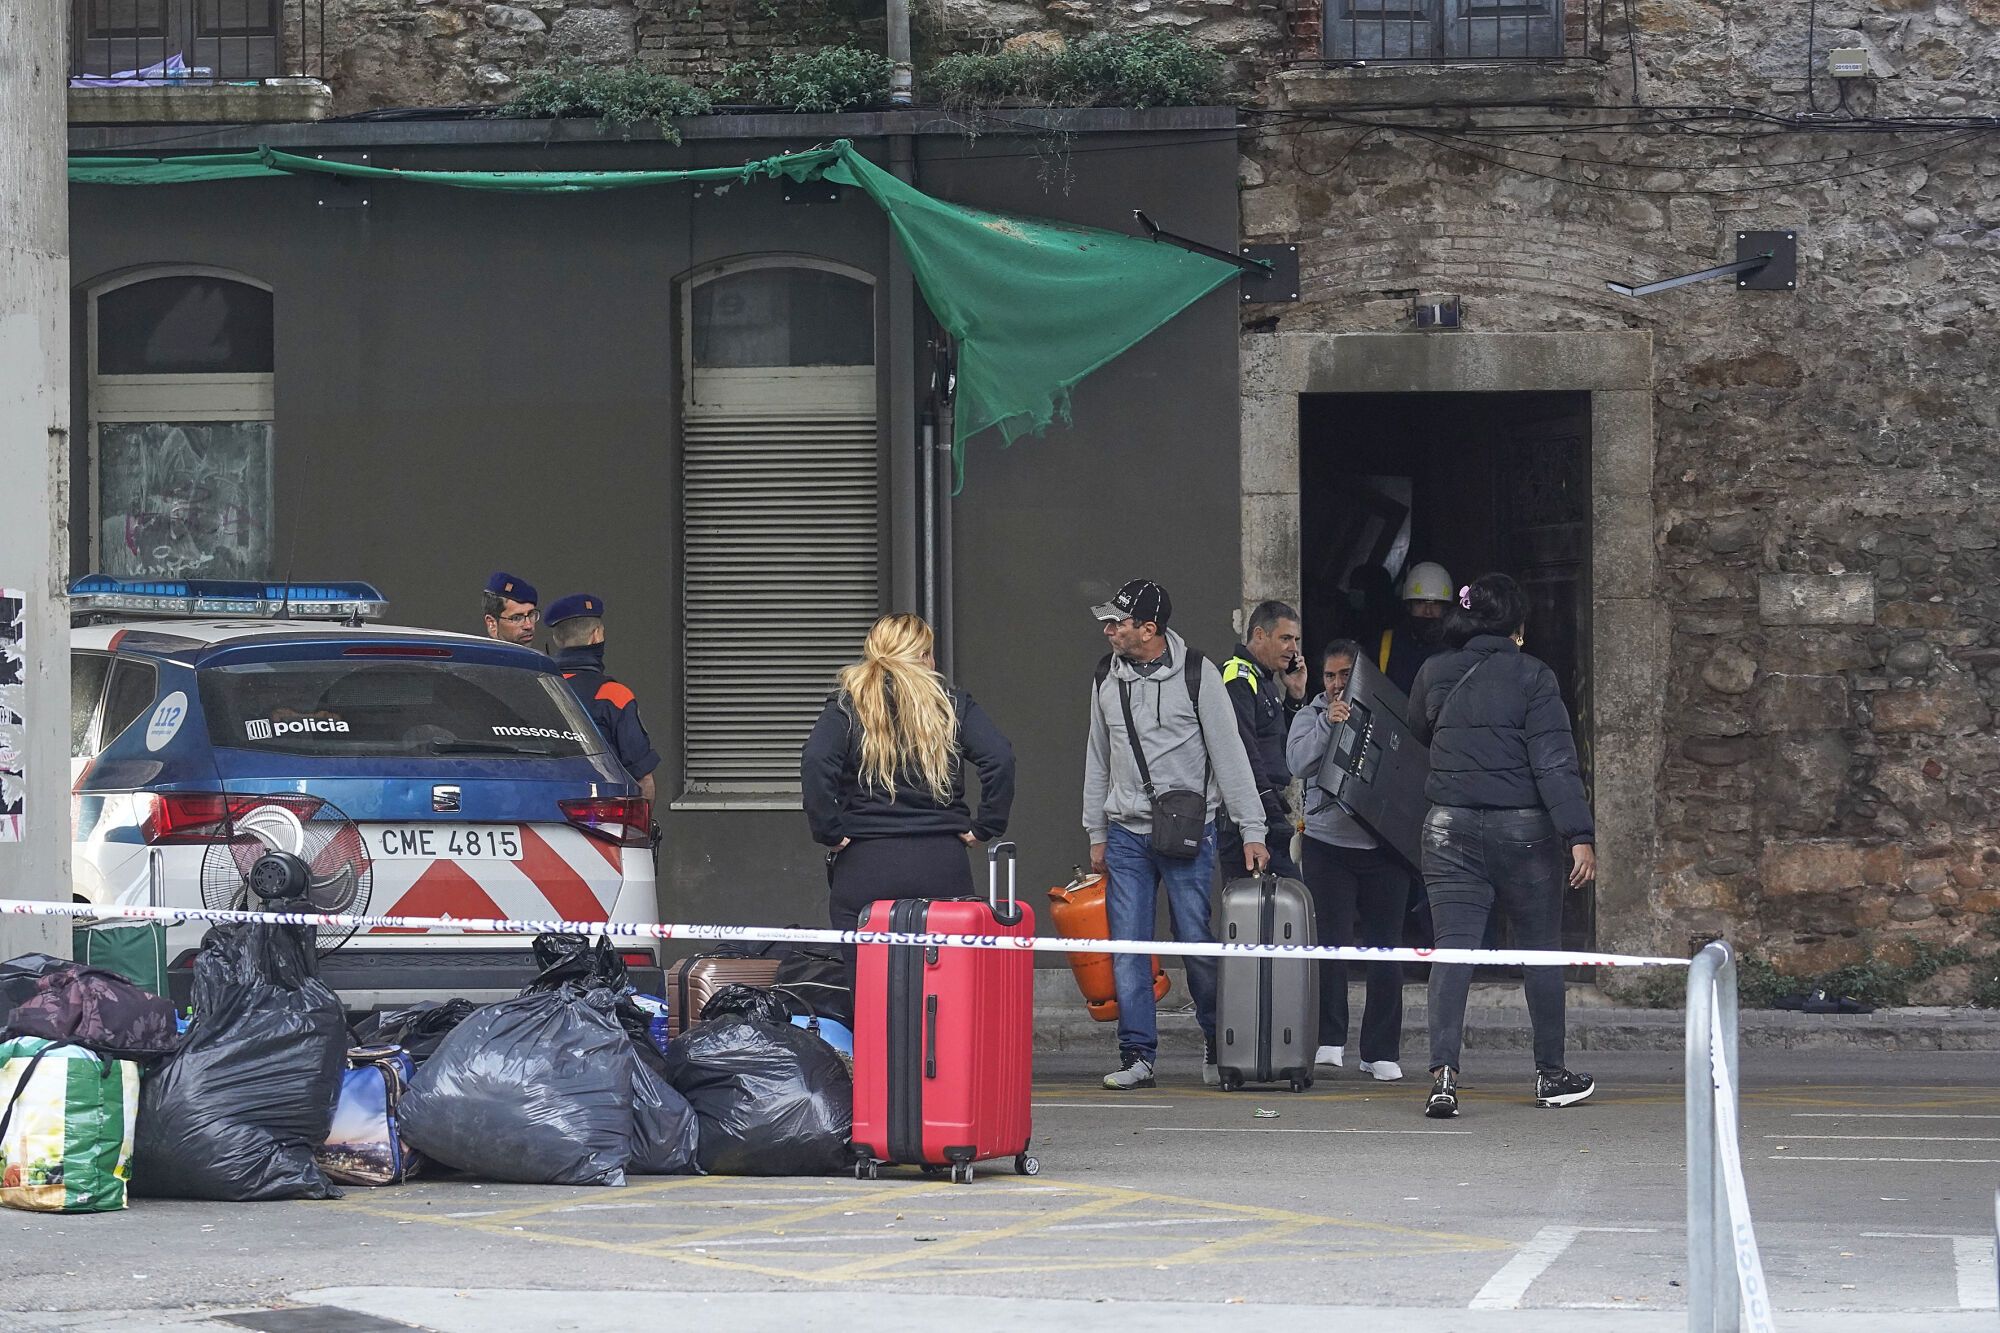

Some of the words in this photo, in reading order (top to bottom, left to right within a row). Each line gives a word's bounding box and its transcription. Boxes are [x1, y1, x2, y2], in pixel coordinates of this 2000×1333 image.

[1432, 303, 1443, 325] 1
[155, 706, 181, 727] 112
[273, 718, 350, 737] policia
[491, 726, 590, 744] mossos.cat
[382, 829, 436, 856] CME
[448, 830, 518, 857] 4815
